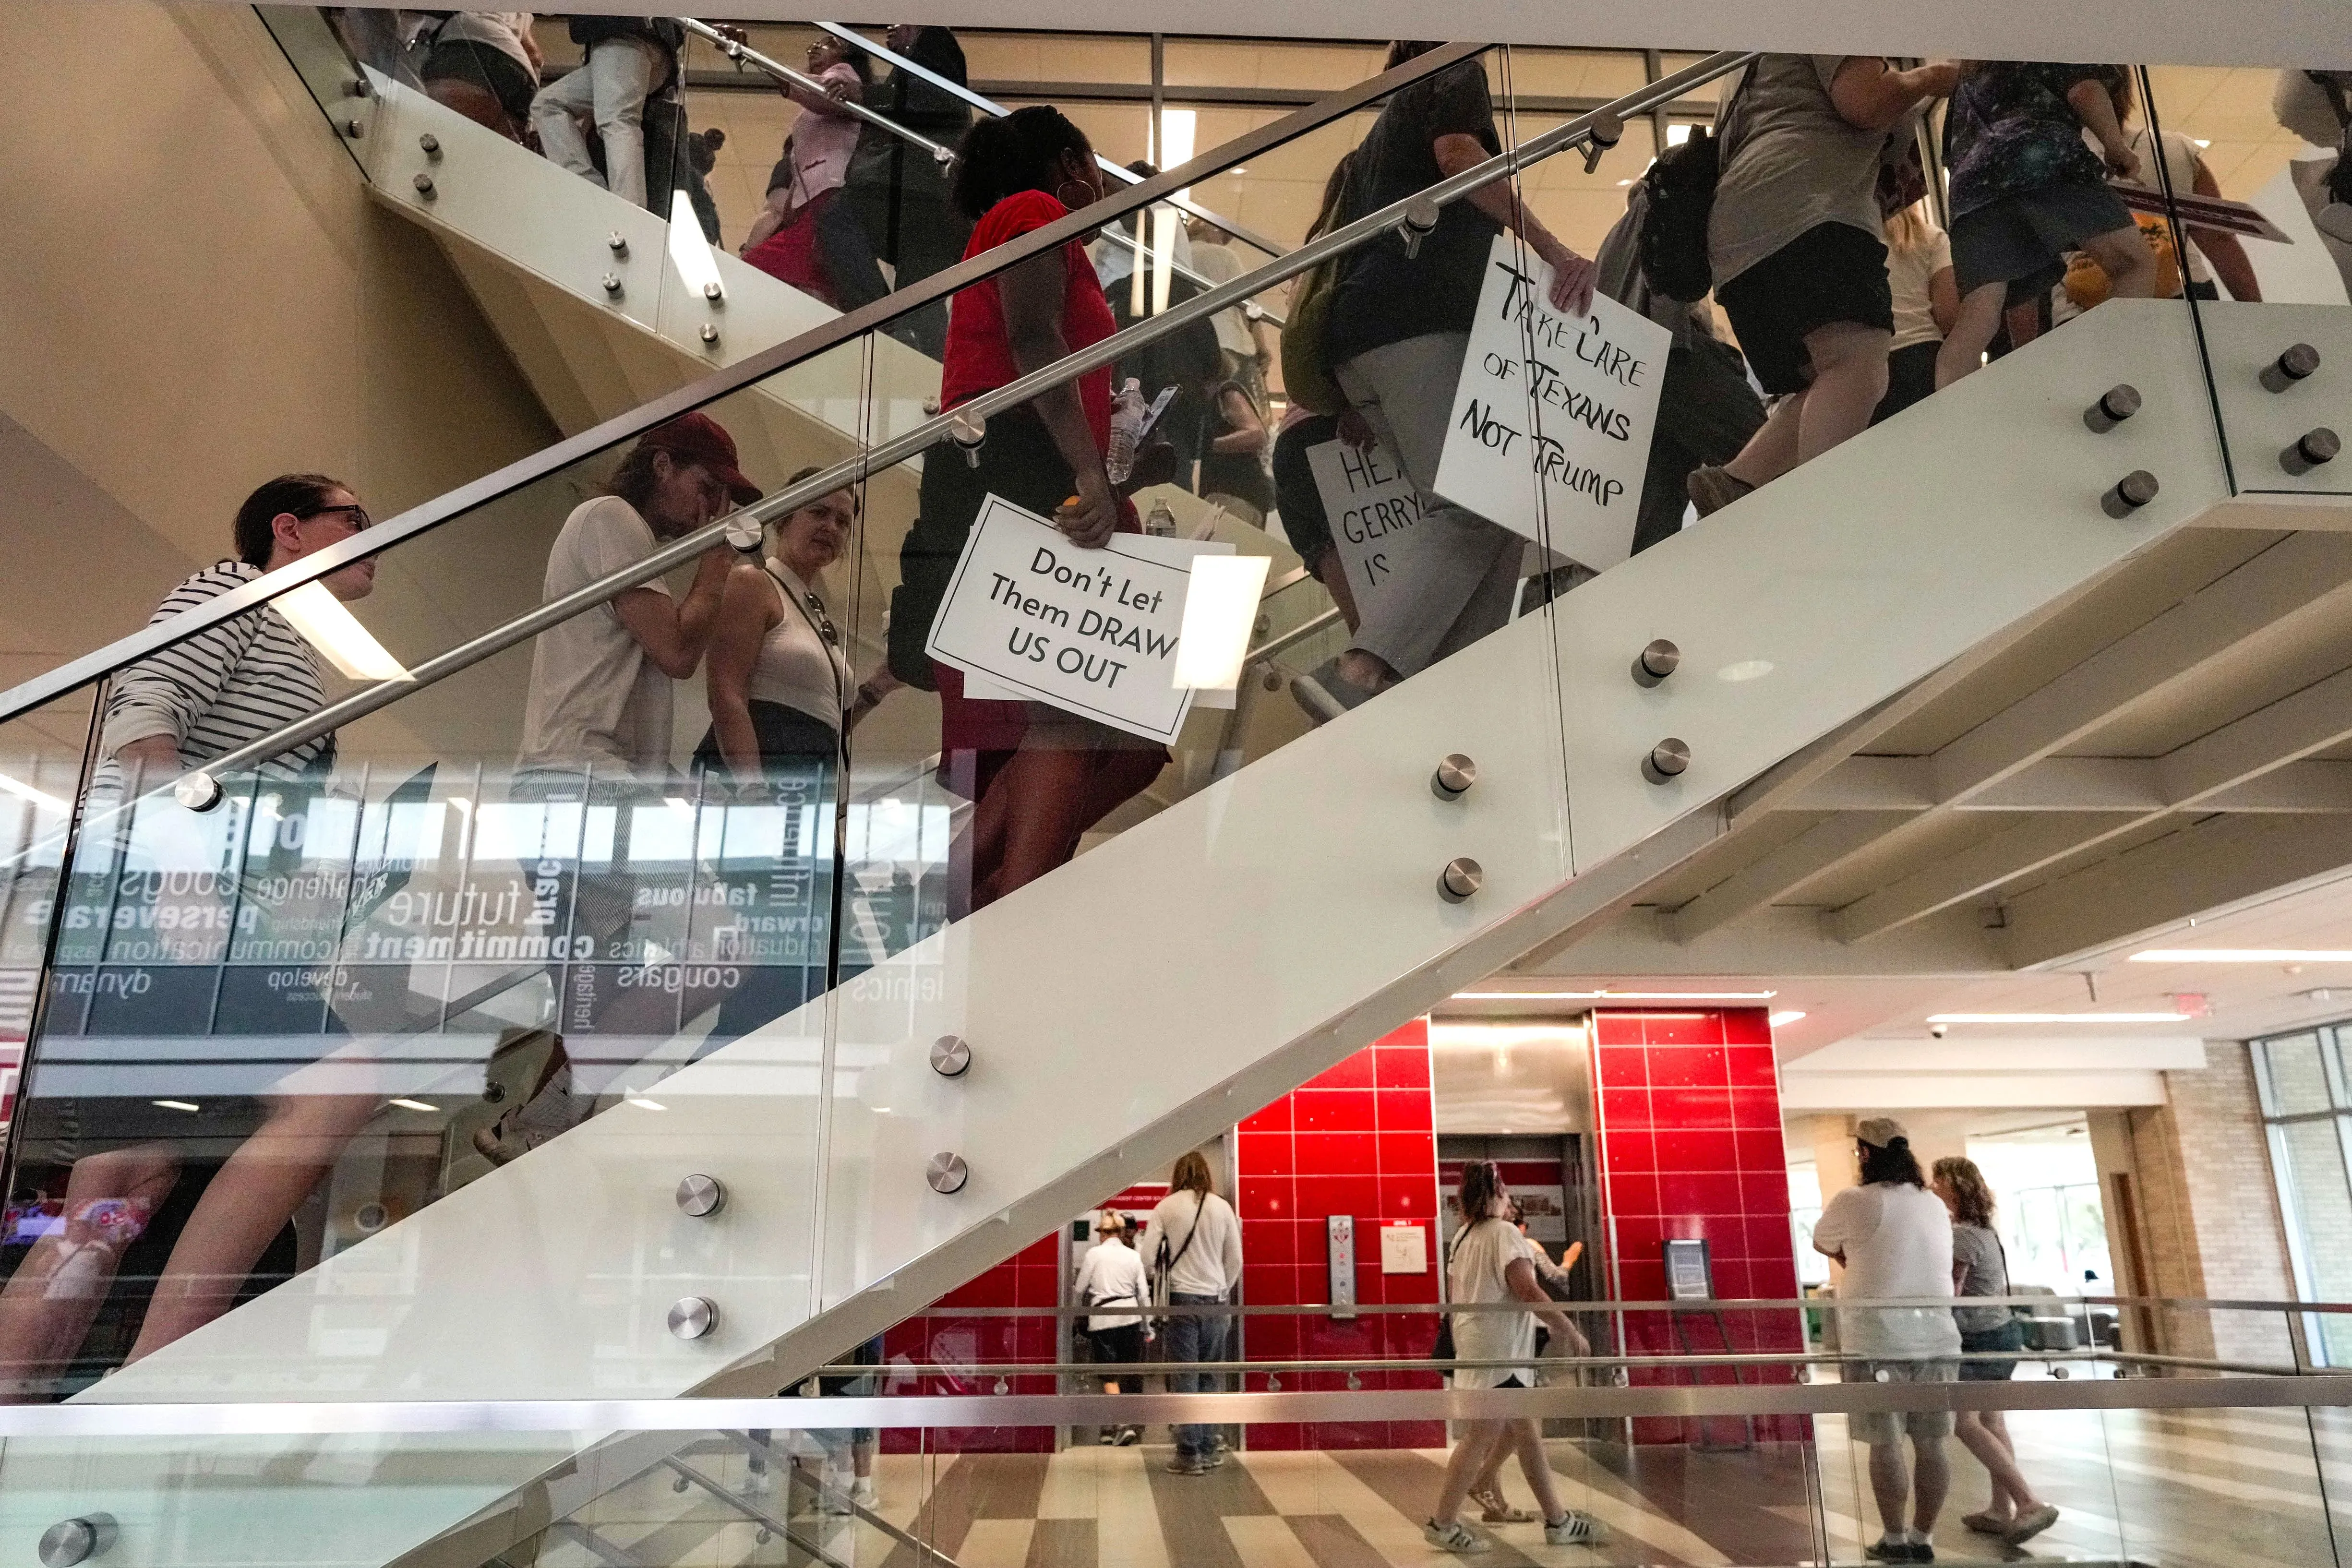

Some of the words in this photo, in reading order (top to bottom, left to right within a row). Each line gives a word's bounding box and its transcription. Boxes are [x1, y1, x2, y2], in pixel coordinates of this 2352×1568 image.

[1495, 262, 1568, 348] TAKE
[1576, 315, 1646, 387] CARE
[1460, 399, 1522, 457] NOT
[1484, 353, 1519, 379] OF
[1525, 359, 1630, 442] TEXANS
[1340, 443, 1402, 493] HE
[1344, 491, 1426, 543] GERRY
[1030, 547, 1113, 598] Don't
[1117, 578, 1163, 614] Let
[987, 572, 1070, 628] Them
[1077, 609, 1179, 660] DRAW
[1008, 626, 1049, 663] US
[1056, 646, 1128, 688] OUT
